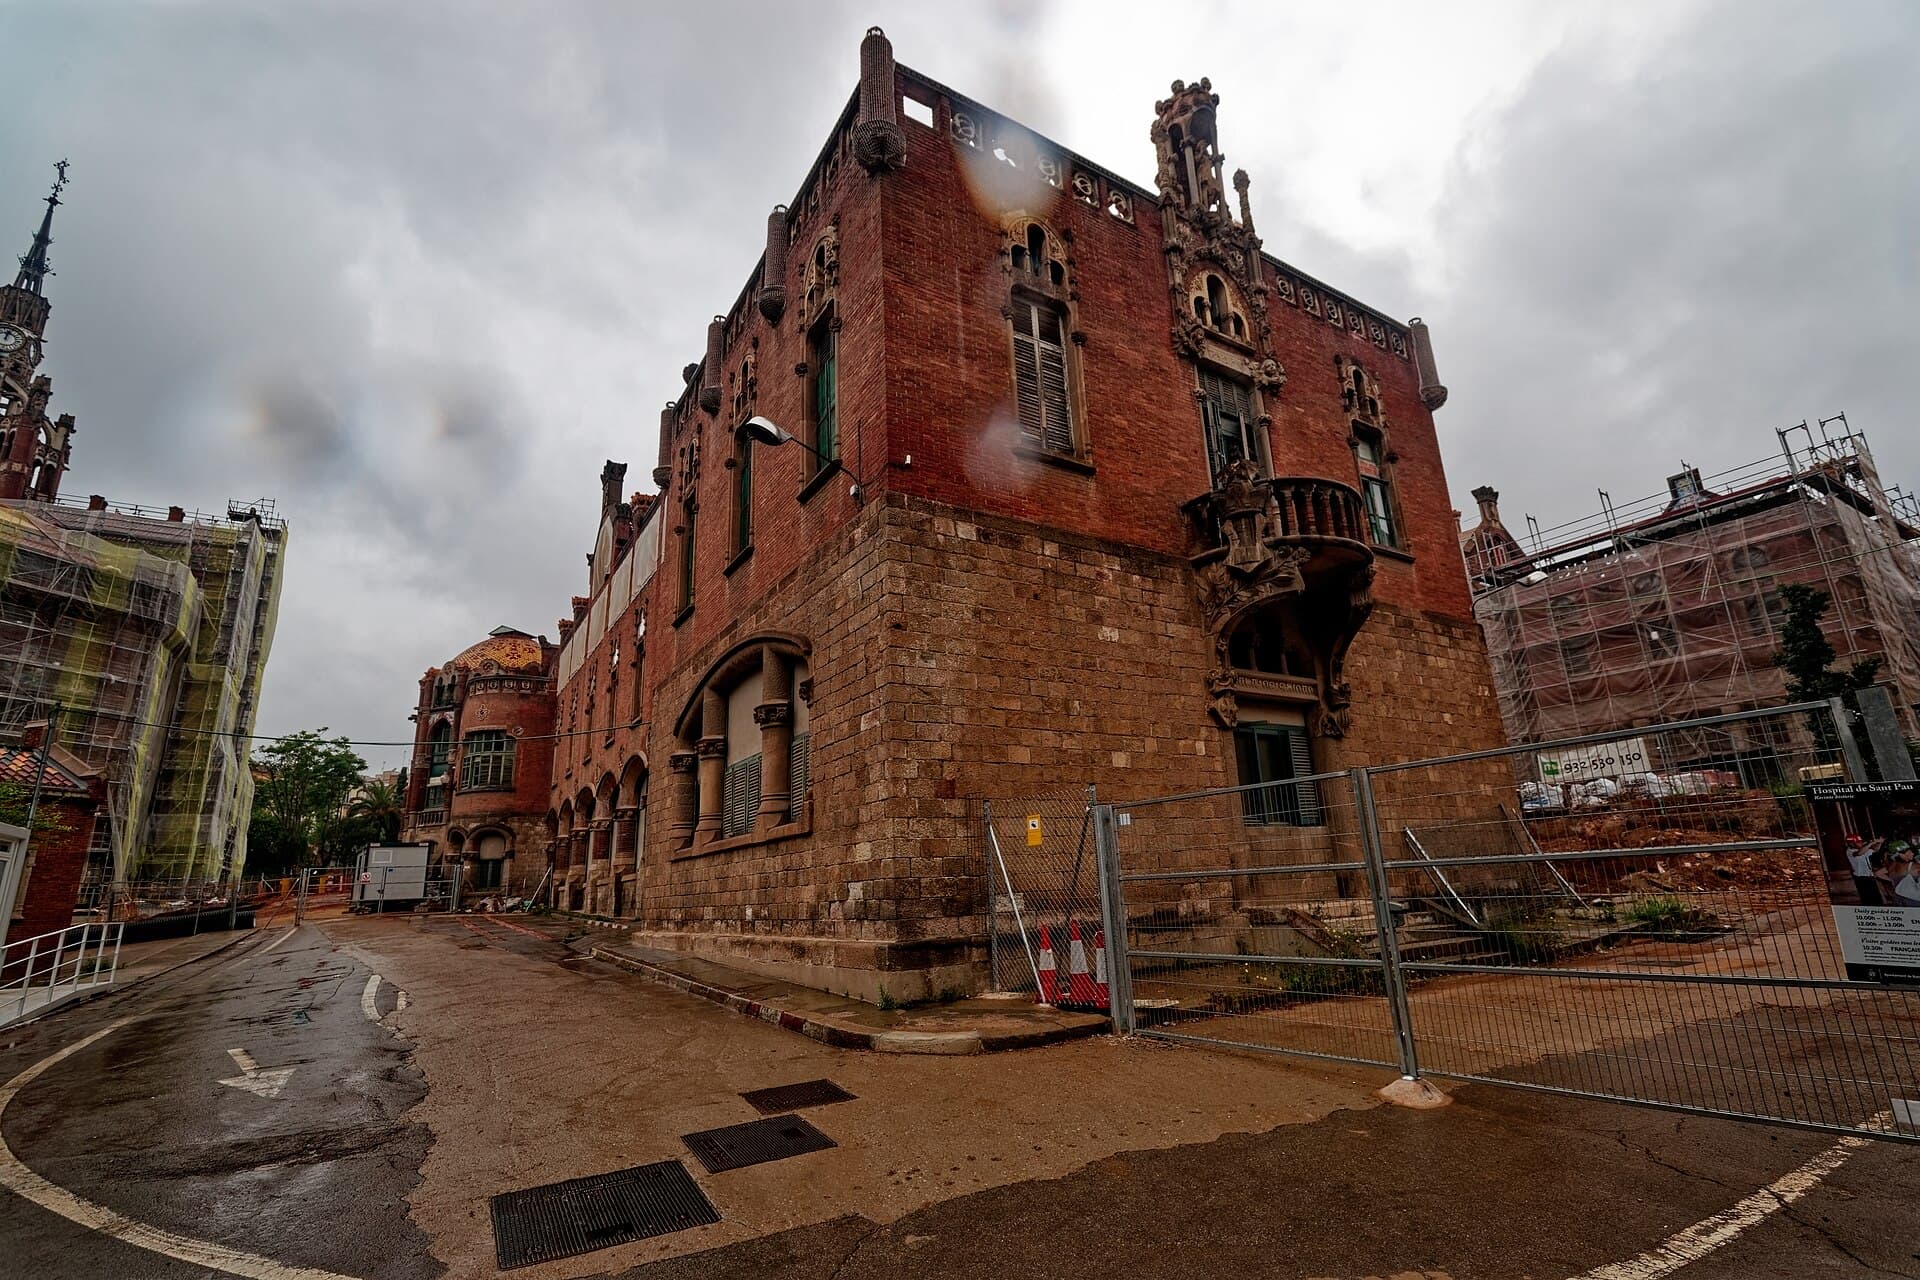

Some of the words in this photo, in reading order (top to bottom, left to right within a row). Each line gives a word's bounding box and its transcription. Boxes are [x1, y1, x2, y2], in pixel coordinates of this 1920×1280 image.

[1564, 761, 1587, 774] 932
[1592, 757, 1614, 770] 530
[1619, 753, 1641, 765] 150
[1812, 785, 1854, 795] Hospital
[1855, 784, 1868, 792] de
[1868, 783, 1892, 792] Sant
[1893, 782, 1914, 790] Pau
